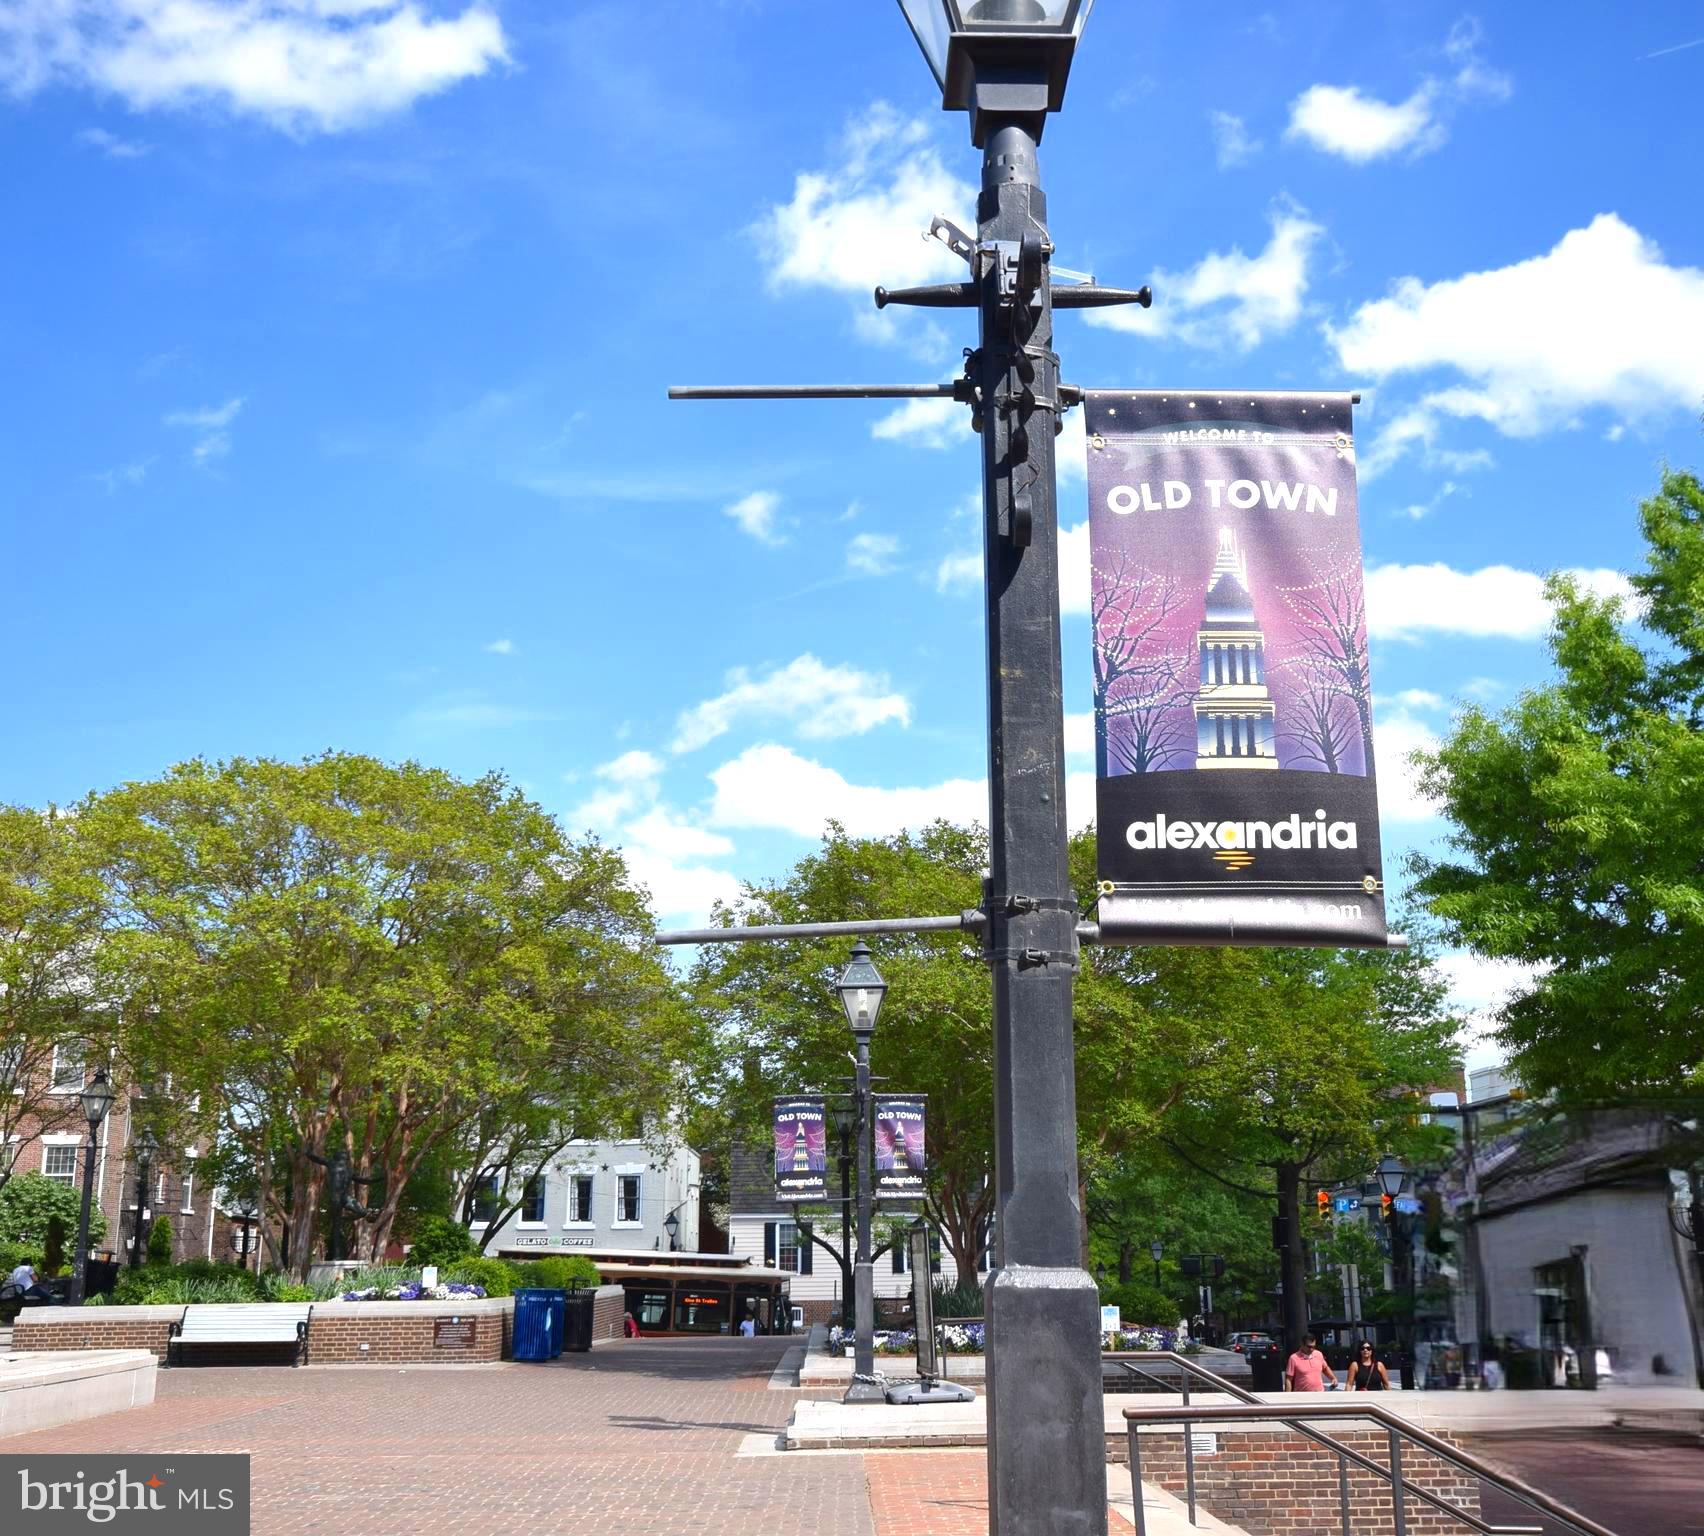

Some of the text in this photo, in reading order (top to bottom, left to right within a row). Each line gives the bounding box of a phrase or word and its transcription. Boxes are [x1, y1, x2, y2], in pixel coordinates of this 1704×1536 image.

[1163, 428, 1275, 446] WELCOME TO
[1106, 479, 1338, 516] OLD TOWN
[1126, 808, 1358, 850] alexandria
[778, 1112, 822, 1122] OLD TOWN
[878, 1111, 922, 1121] OLD TOWN
